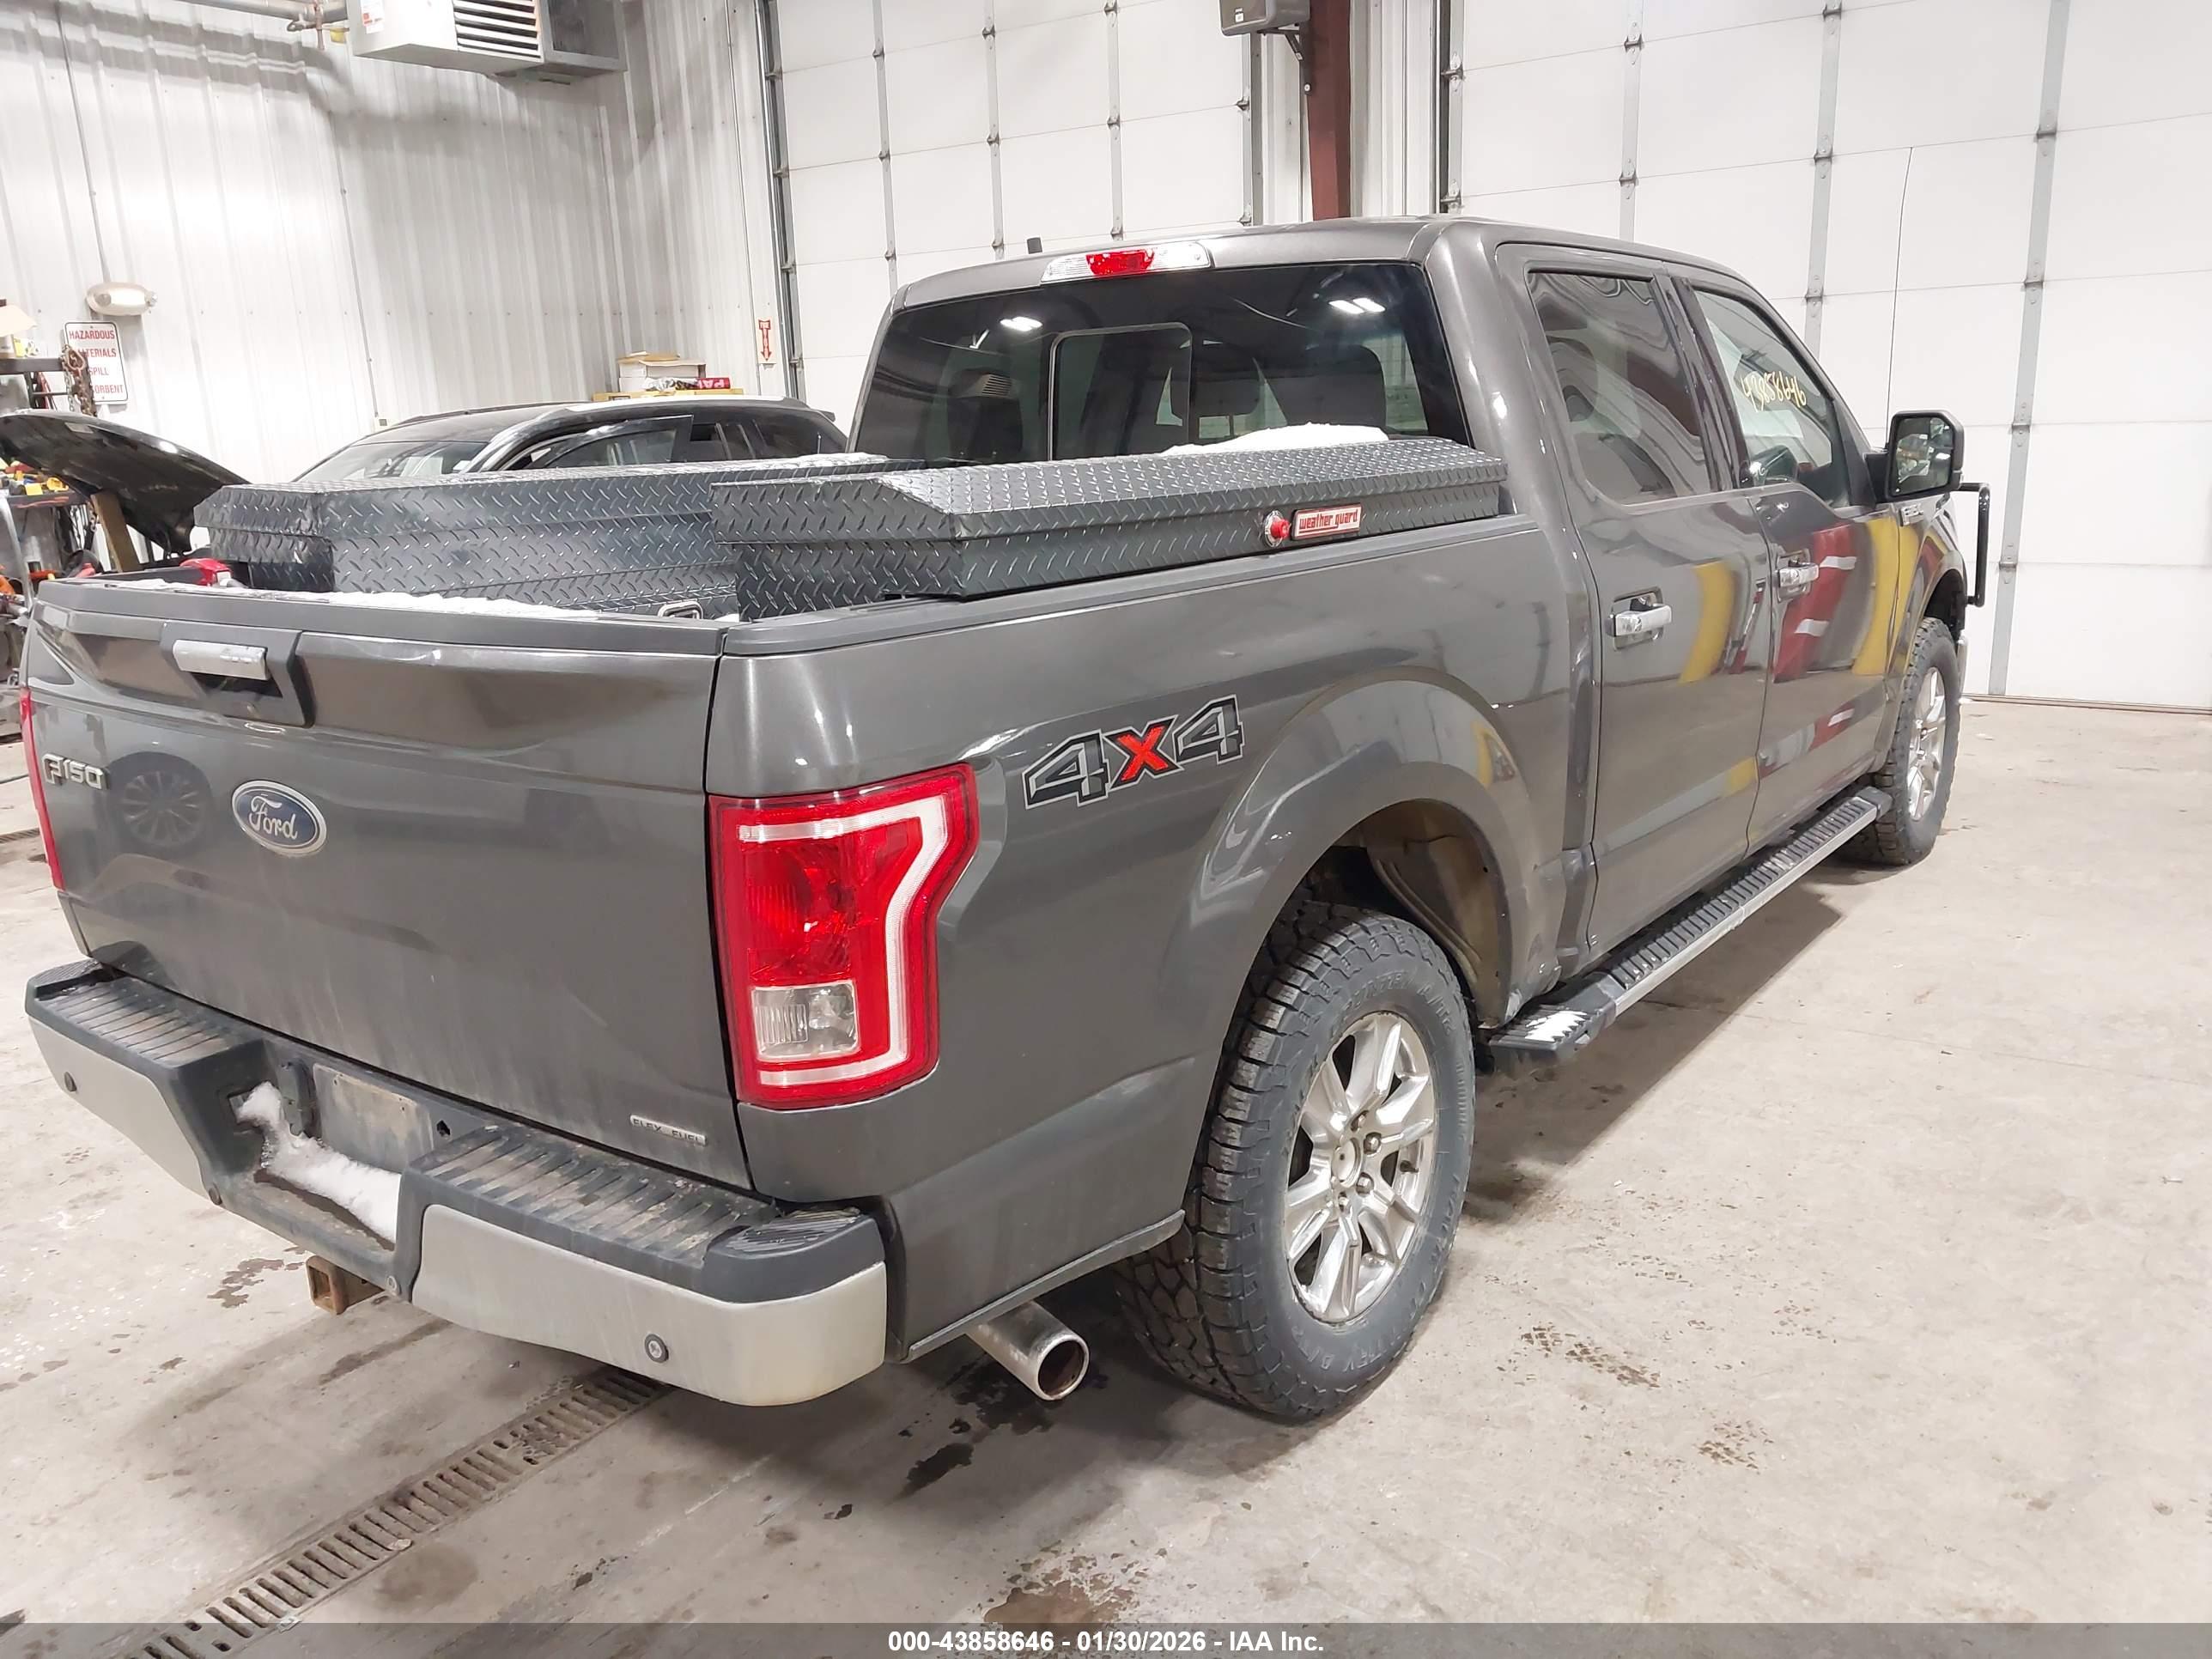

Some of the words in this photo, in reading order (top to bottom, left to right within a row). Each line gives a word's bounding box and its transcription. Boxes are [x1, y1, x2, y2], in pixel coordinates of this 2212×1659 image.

[69, 330, 115, 340] HAZARDOUS
[88, 367, 109, 375] SPILL
[94, 384, 124, 394] ORBENT
[1741, 371, 1807, 412] 43858646
[1299, 514, 1333, 530] weather
[1334, 508, 1358, 529] guard
[248, 793, 298, 841] Ford
[633, 1118, 661, 1132] FLEX
[672, 1129, 702, 1143] FUEL
